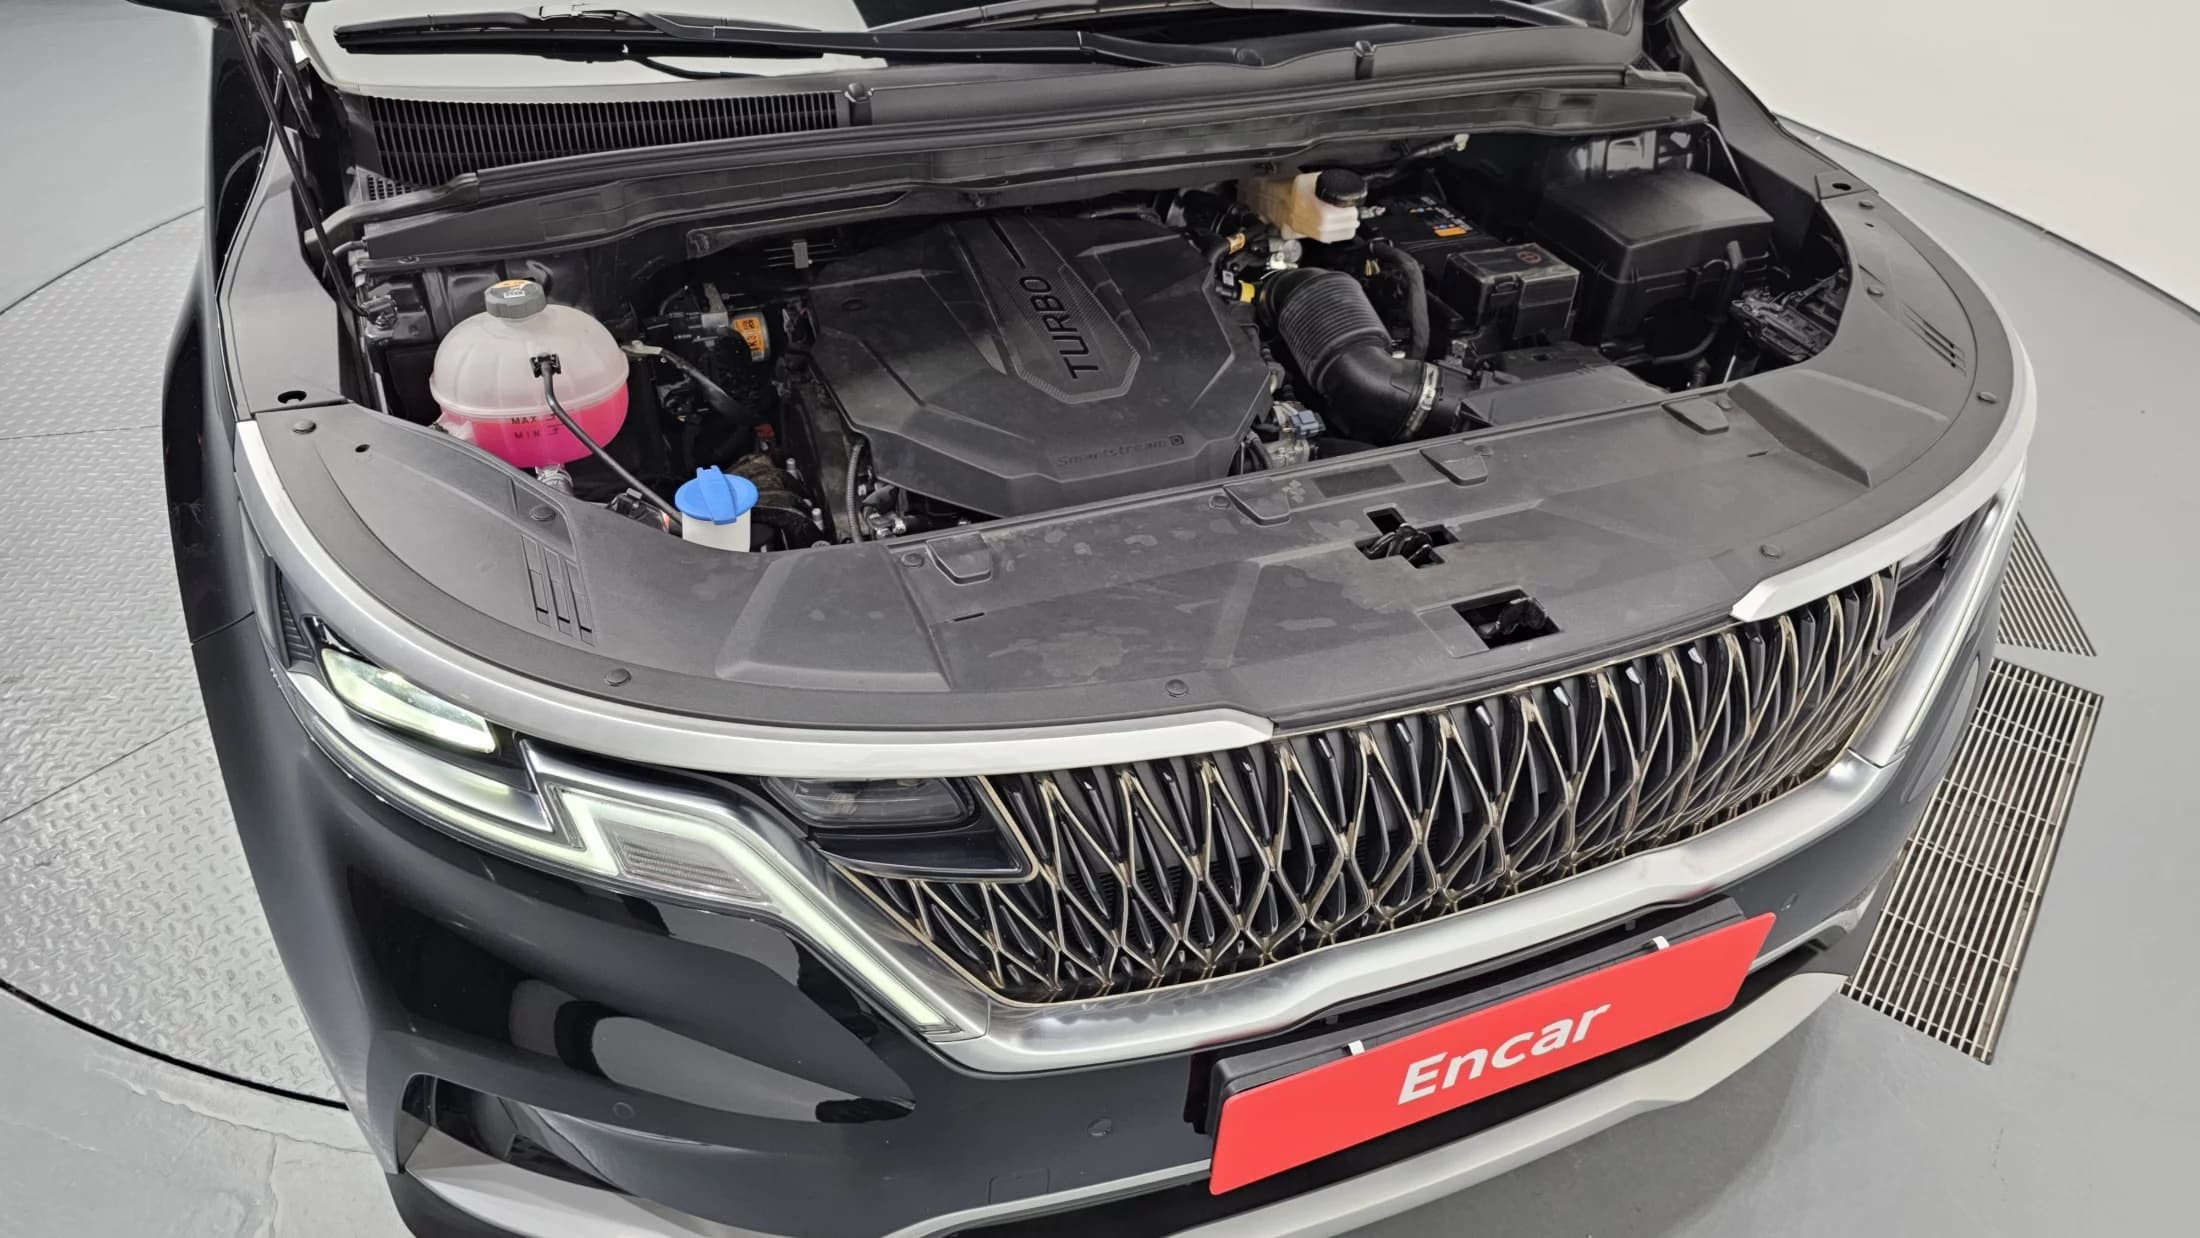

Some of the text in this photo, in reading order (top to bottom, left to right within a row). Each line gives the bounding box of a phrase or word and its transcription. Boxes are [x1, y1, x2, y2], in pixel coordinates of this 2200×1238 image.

[1020, 276, 1099, 379] TURBO
[511, 415, 537, 425] MAX
[514, 429, 541, 439] MIN
[1398, 1003, 1612, 1105] Encar
